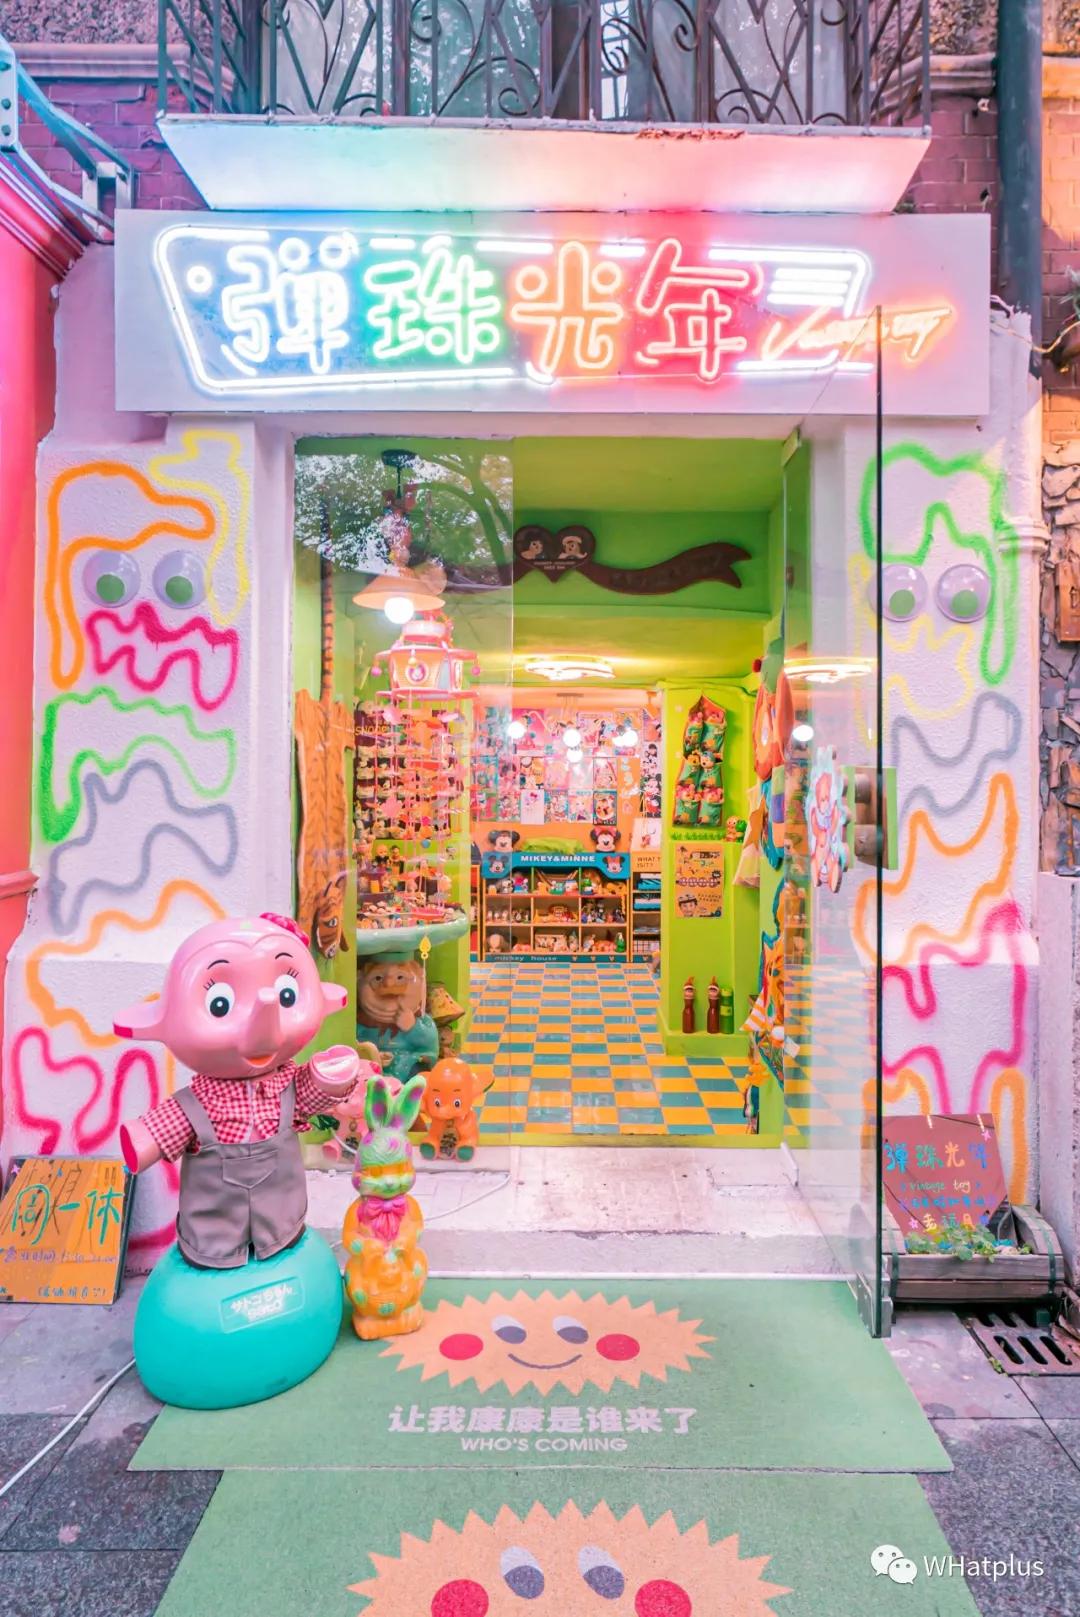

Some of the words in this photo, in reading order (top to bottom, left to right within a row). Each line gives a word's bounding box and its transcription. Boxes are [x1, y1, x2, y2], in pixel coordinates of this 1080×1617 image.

[221, 236, 751, 382] 弹珠光年
[388, 1405, 697, 1434] 让我康康是谁来了
[460, 1437, 529, 1451] WHO'S
[535, 1437, 628, 1451] COMING
